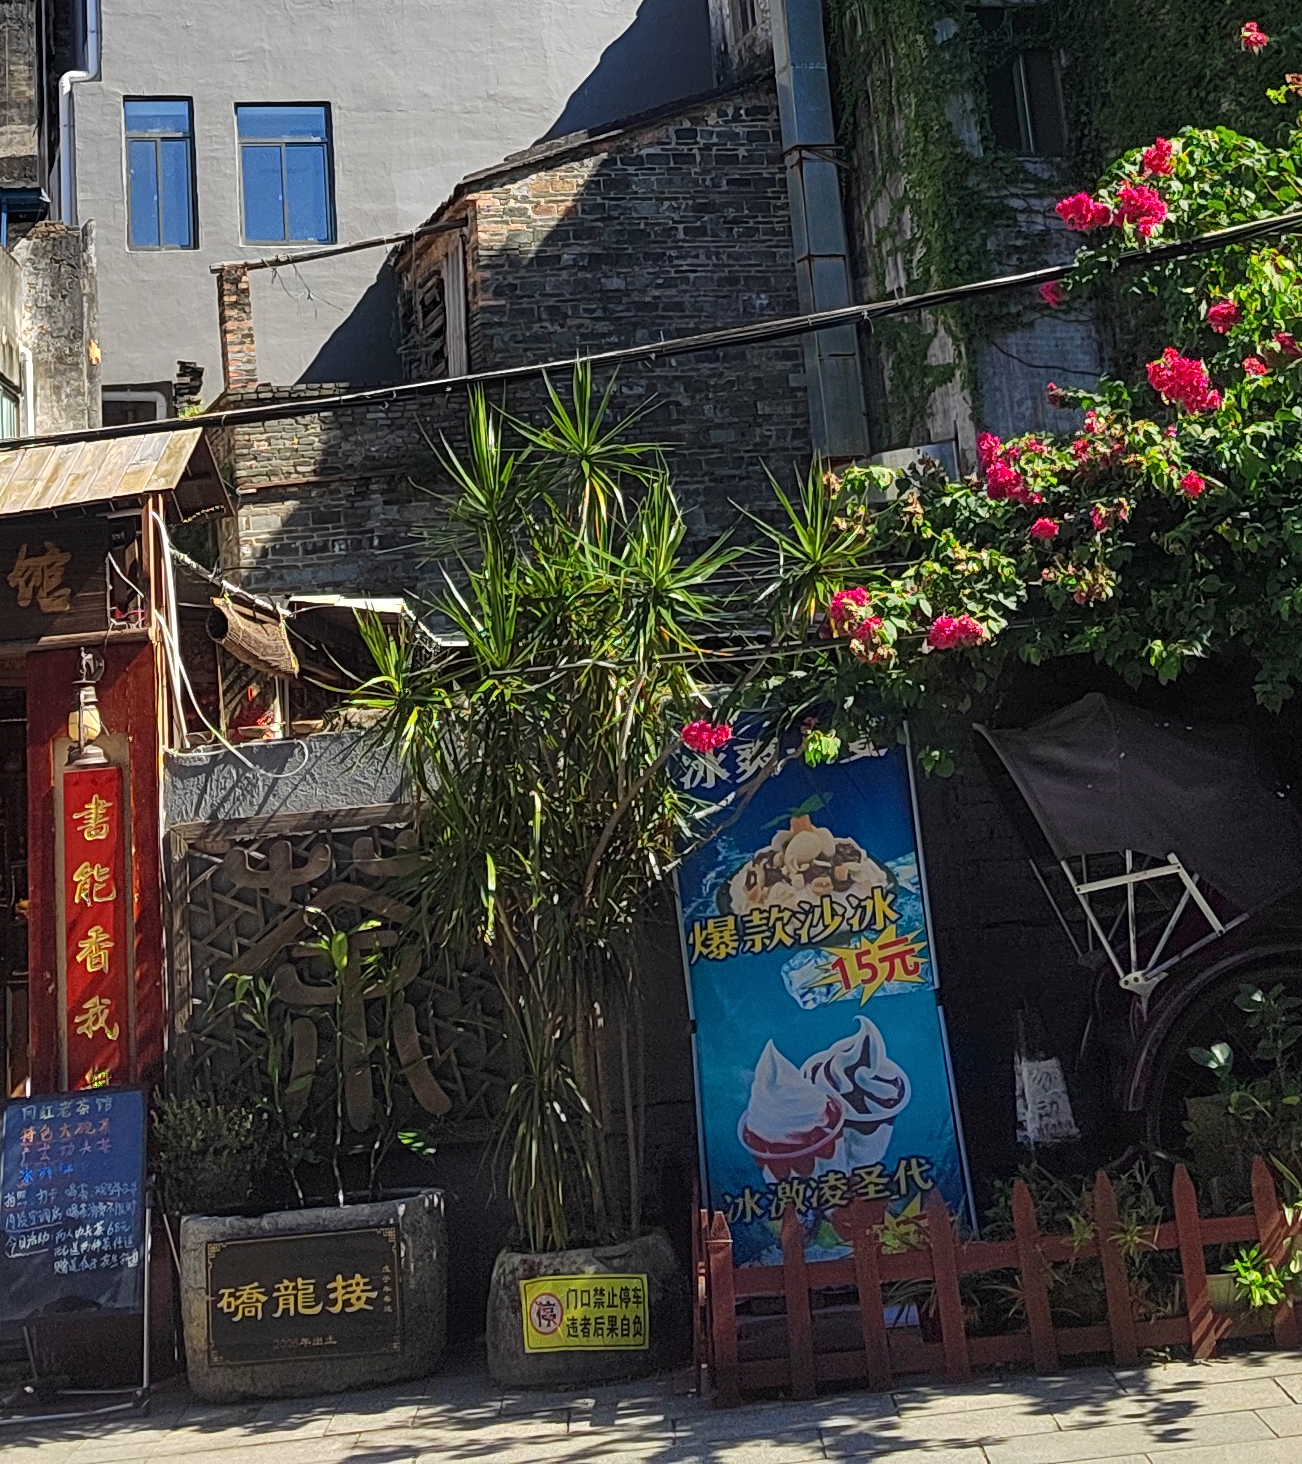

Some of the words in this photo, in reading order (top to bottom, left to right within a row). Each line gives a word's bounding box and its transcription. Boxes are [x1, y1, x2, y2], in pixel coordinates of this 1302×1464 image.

[688, 885, 901, 964] 爆款沙冰
[830, 937, 921, 992] 15元
[723, 1156, 934, 1225] 冰激凌圣代
[565, 1285, 643, 1310] 门口禁止停车
[565, 1314, 644, 1340] 违者后果自负
